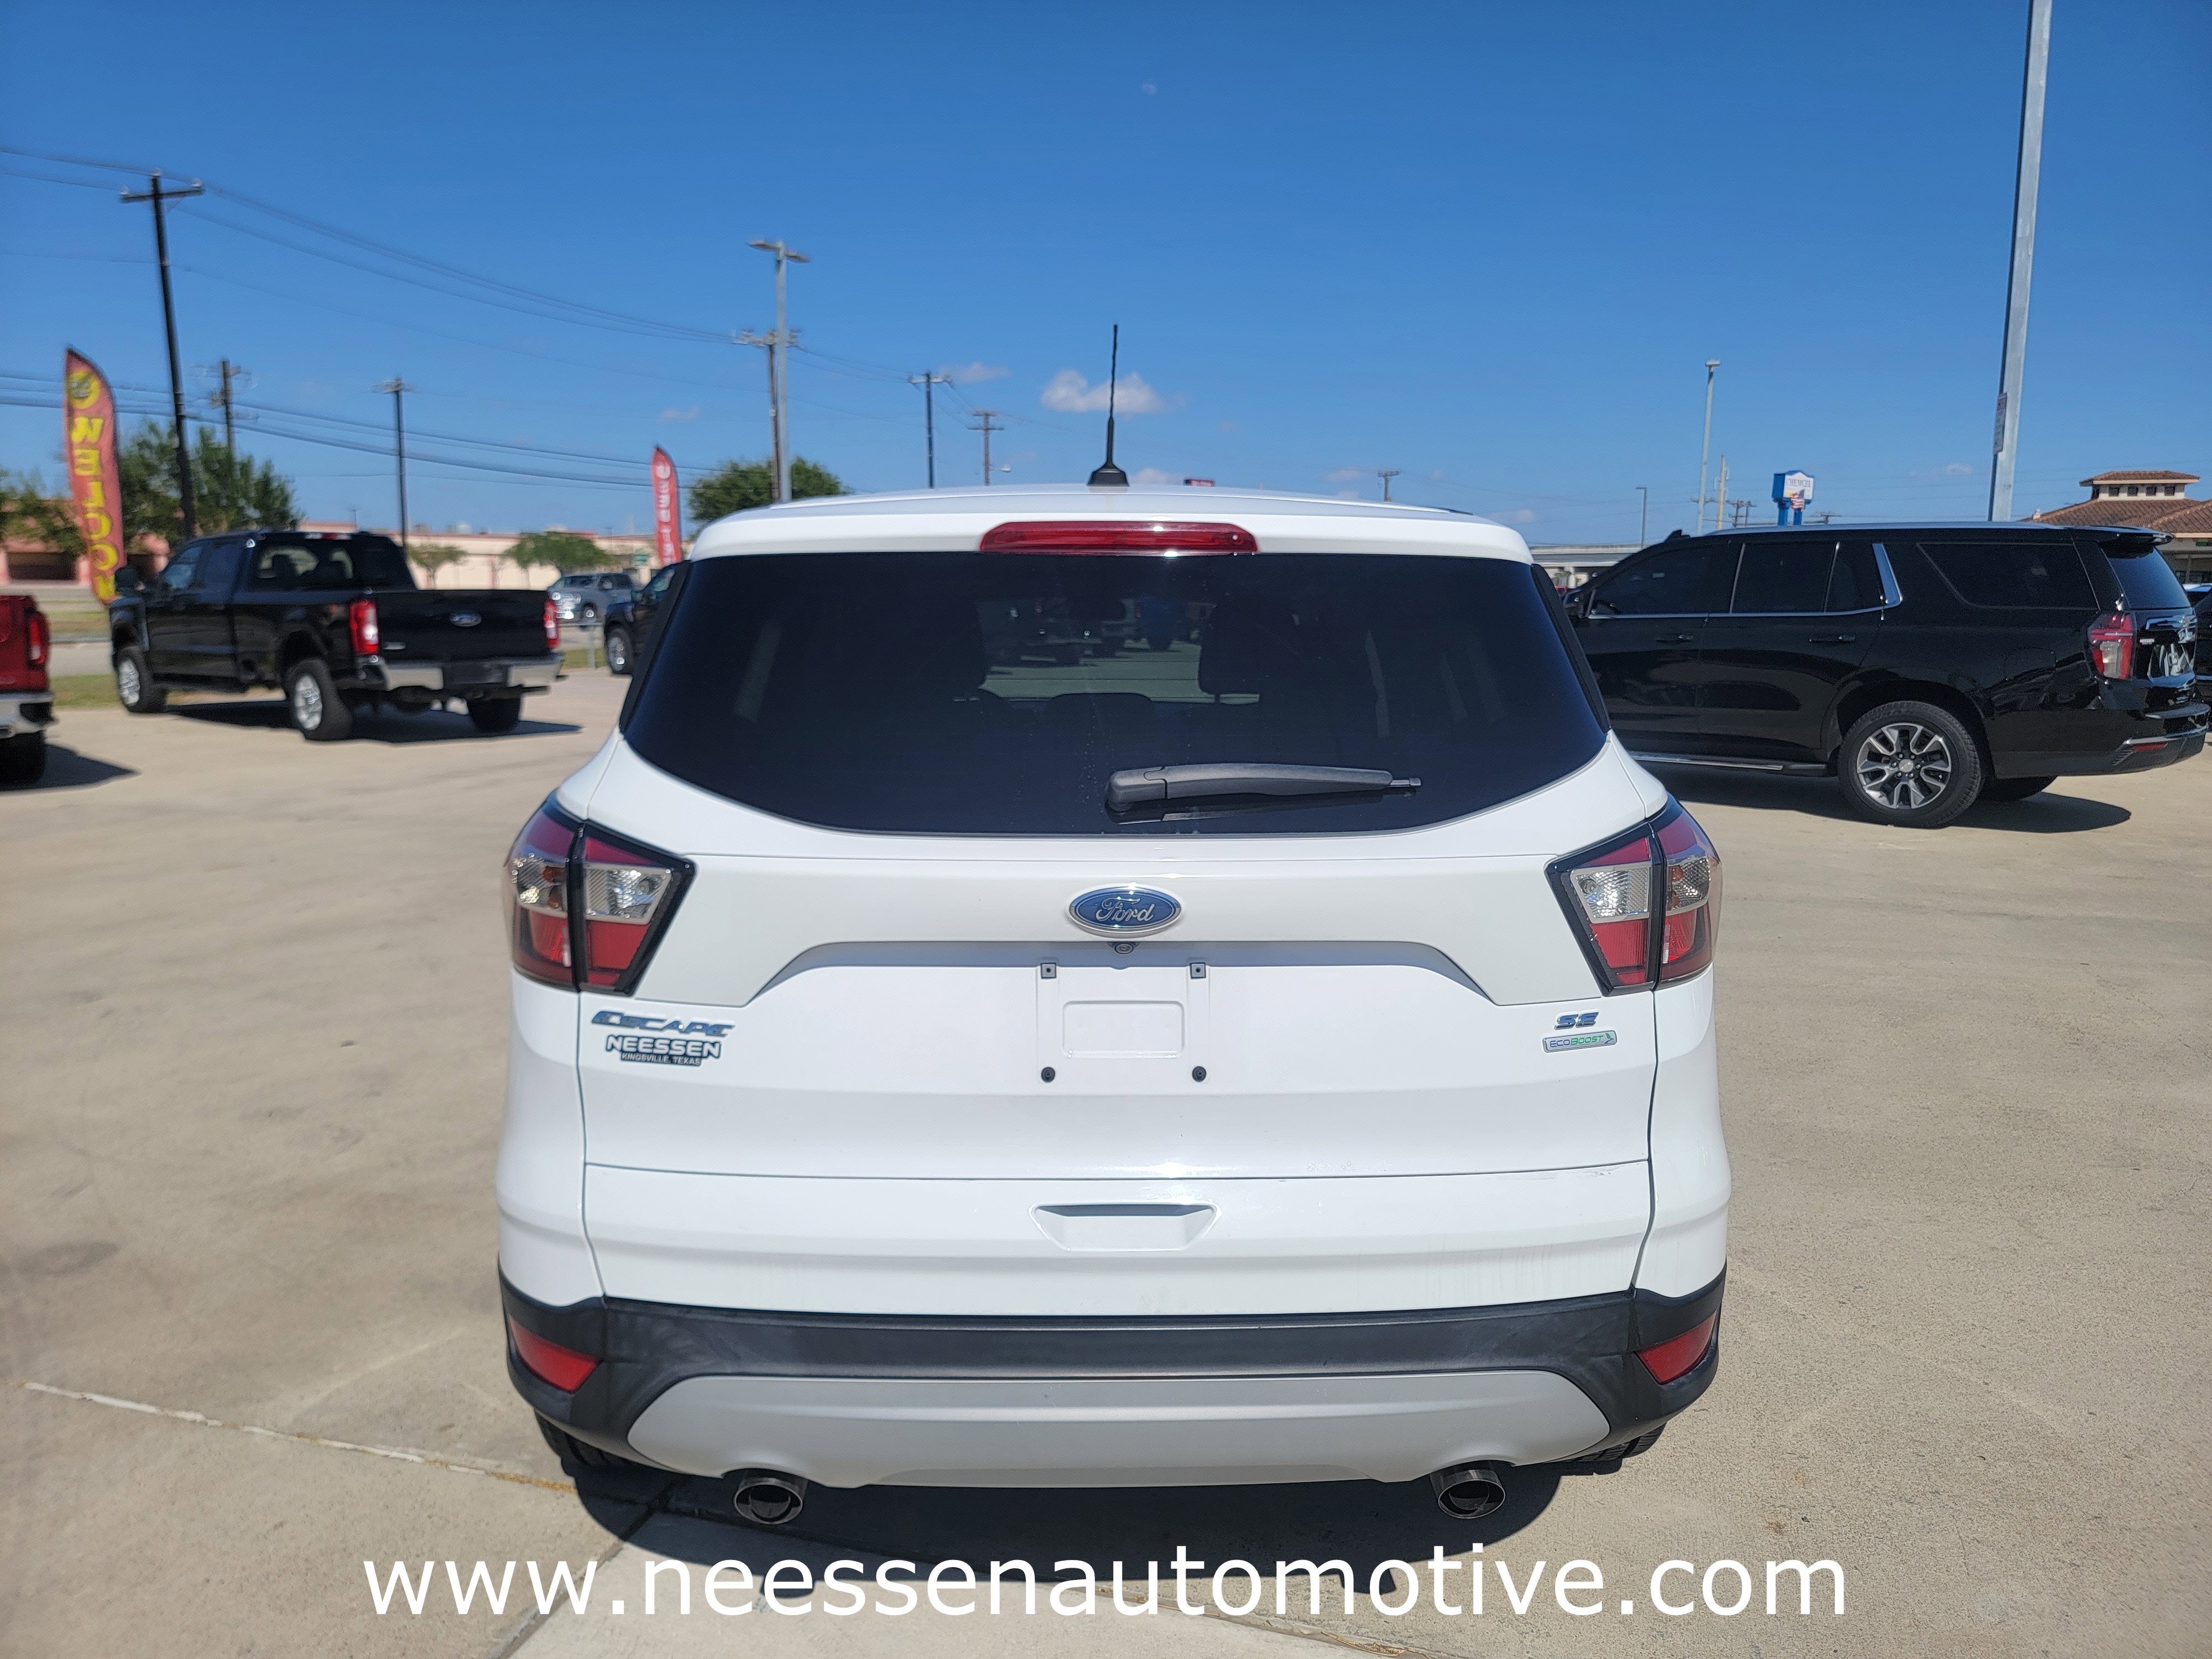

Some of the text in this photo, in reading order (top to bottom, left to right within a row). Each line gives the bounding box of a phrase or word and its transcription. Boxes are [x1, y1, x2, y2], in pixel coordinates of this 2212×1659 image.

[1095, 896, 1155, 922] Ford
[591, 1010, 735, 1037] ESCAPE
[1554, 1011, 1599, 1030] SE
[606, 1035, 721, 1058] NEESSEN
[1550, 1035, 1604, 1048] ECOBOOST
[672, 1056, 701, 1066] TEXAS
